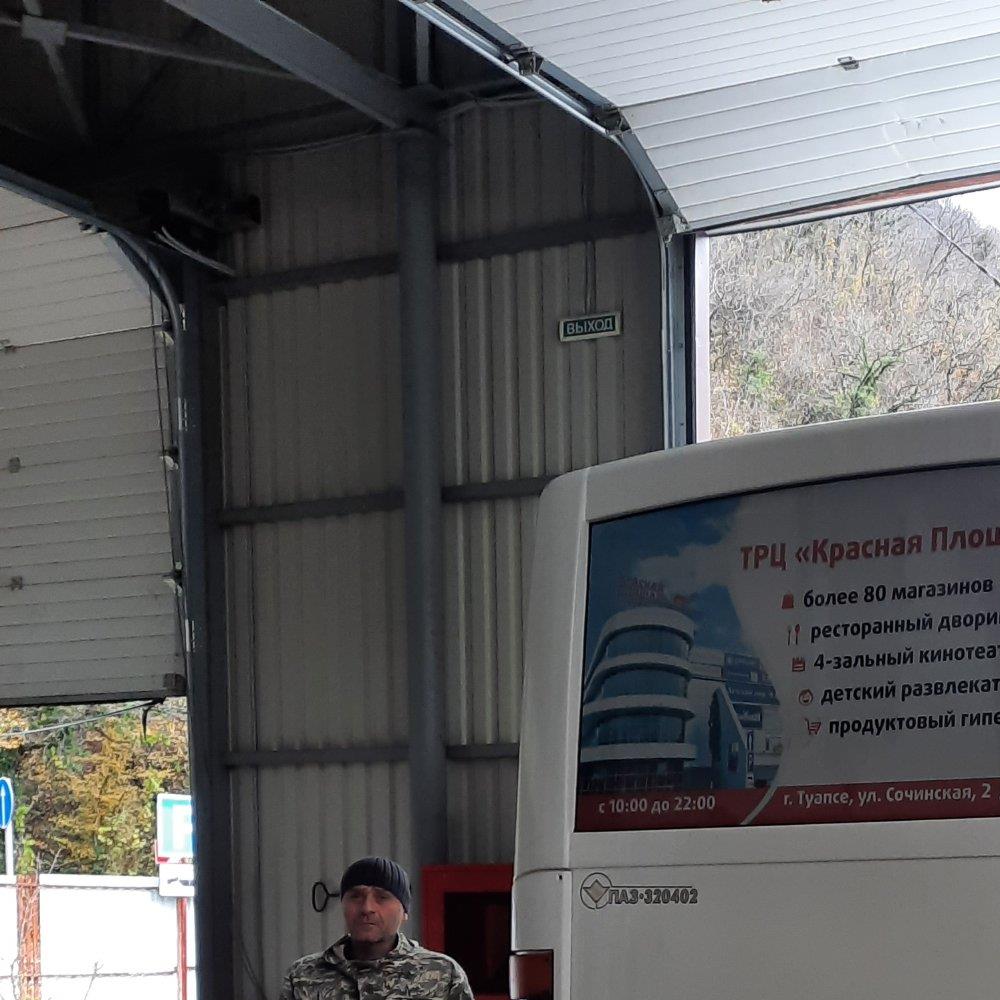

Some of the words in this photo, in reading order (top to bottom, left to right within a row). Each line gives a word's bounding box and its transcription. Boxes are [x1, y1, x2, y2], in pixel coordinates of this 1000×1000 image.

[566, 318, 613, 335] ВЫХОД
[740, 542, 787, 570] ТРЦ
[795, 534, 923, 568] «Красная
[803, 589, 859, 608] более
[863, 584, 887, 603] 80
[891, 578, 994, 601] магазинов
[810, 612, 933, 643] ресторанный
[813, 647, 914, 671] 4-зальный
[820, 680, 896, 706] детский
[828, 710, 955, 738] продуктовый
[610, 798, 648, 813] 10:00
[651, 800, 670, 815] до
[674, 795, 716, 811] 22:00
[783, 794, 793, 806] г.
[796, 791, 853, 809] Туапсе,
[858, 788, 881, 807] ул.
[886, 785, 976, 802] Сочинская,
[981, 783, 992, 798] 2
